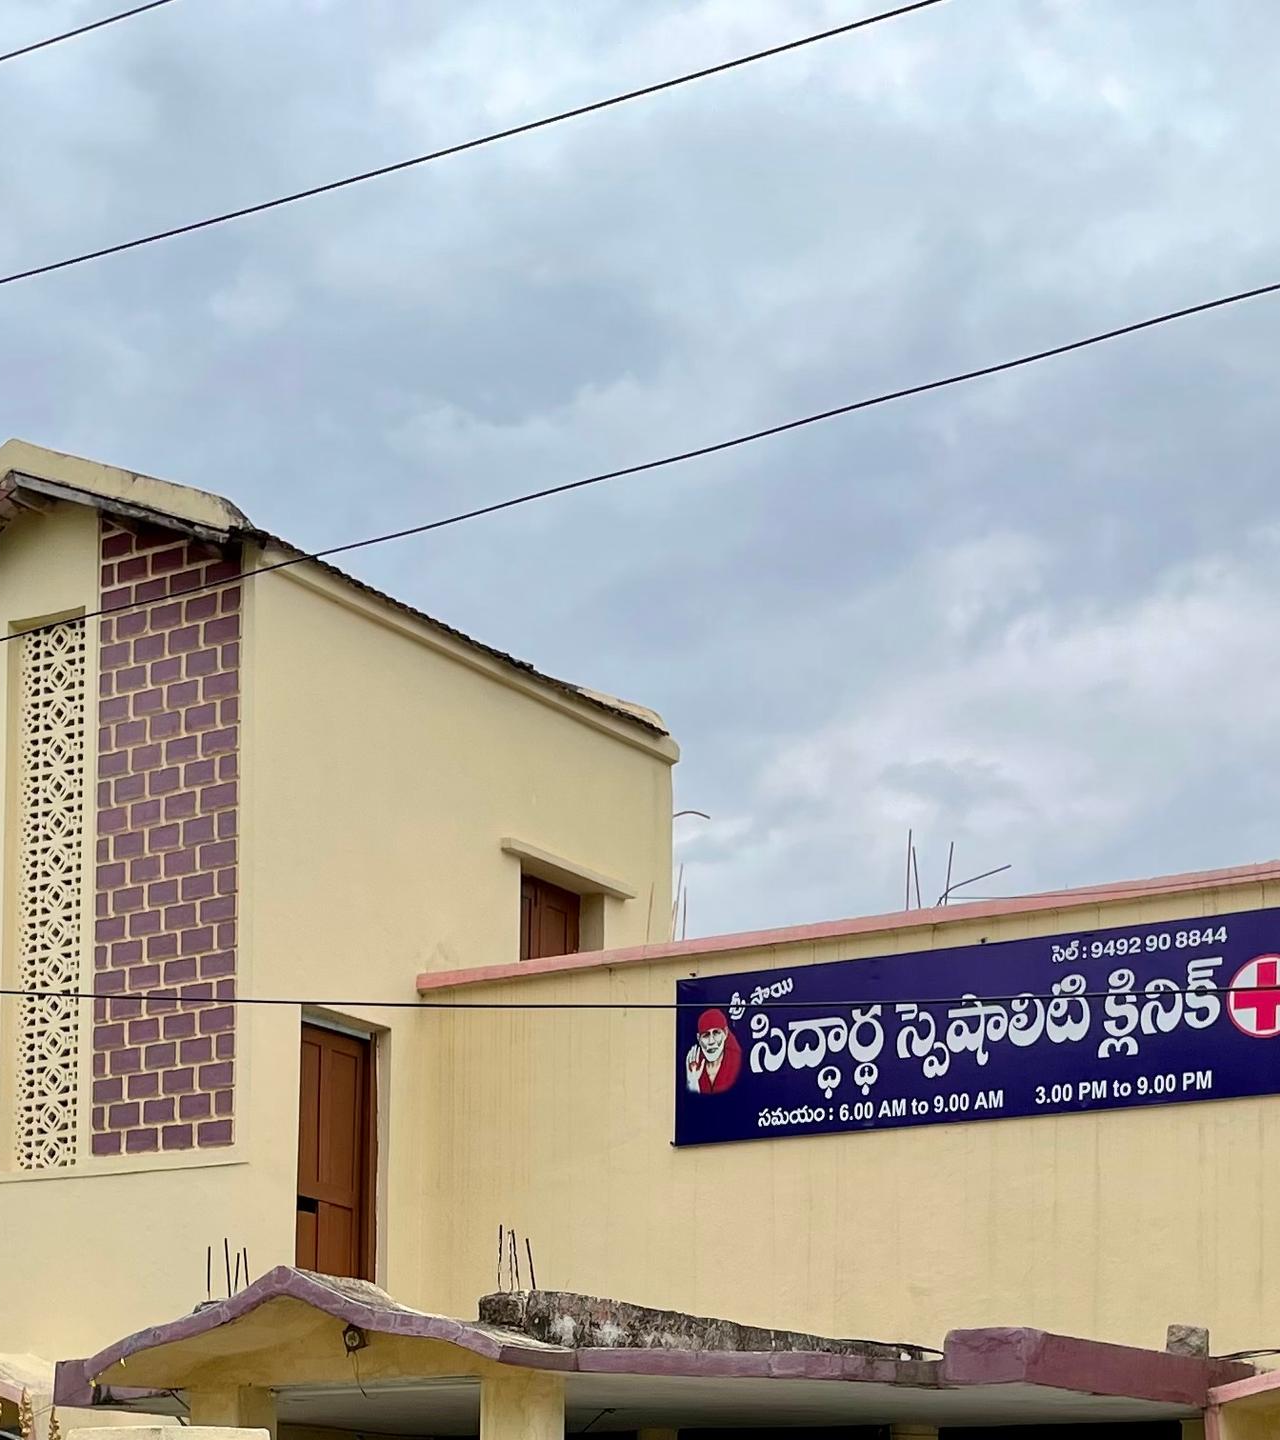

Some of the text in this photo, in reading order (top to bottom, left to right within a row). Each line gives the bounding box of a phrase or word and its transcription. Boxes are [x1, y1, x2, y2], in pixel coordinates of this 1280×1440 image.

[1052, 926, 1227, 962] సెల్ 9492 90 8844
[750, 1004, 884, 1097] సిద్ధార్థ
[1098, 957, 1223, 1058] క్లినిక్
[1035, 1070, 1212, 1104] 3.00 PM to 9.00 PM
[758, 1090, 1003, 1127] సమయం 6.00 AM to 9.00 AM
